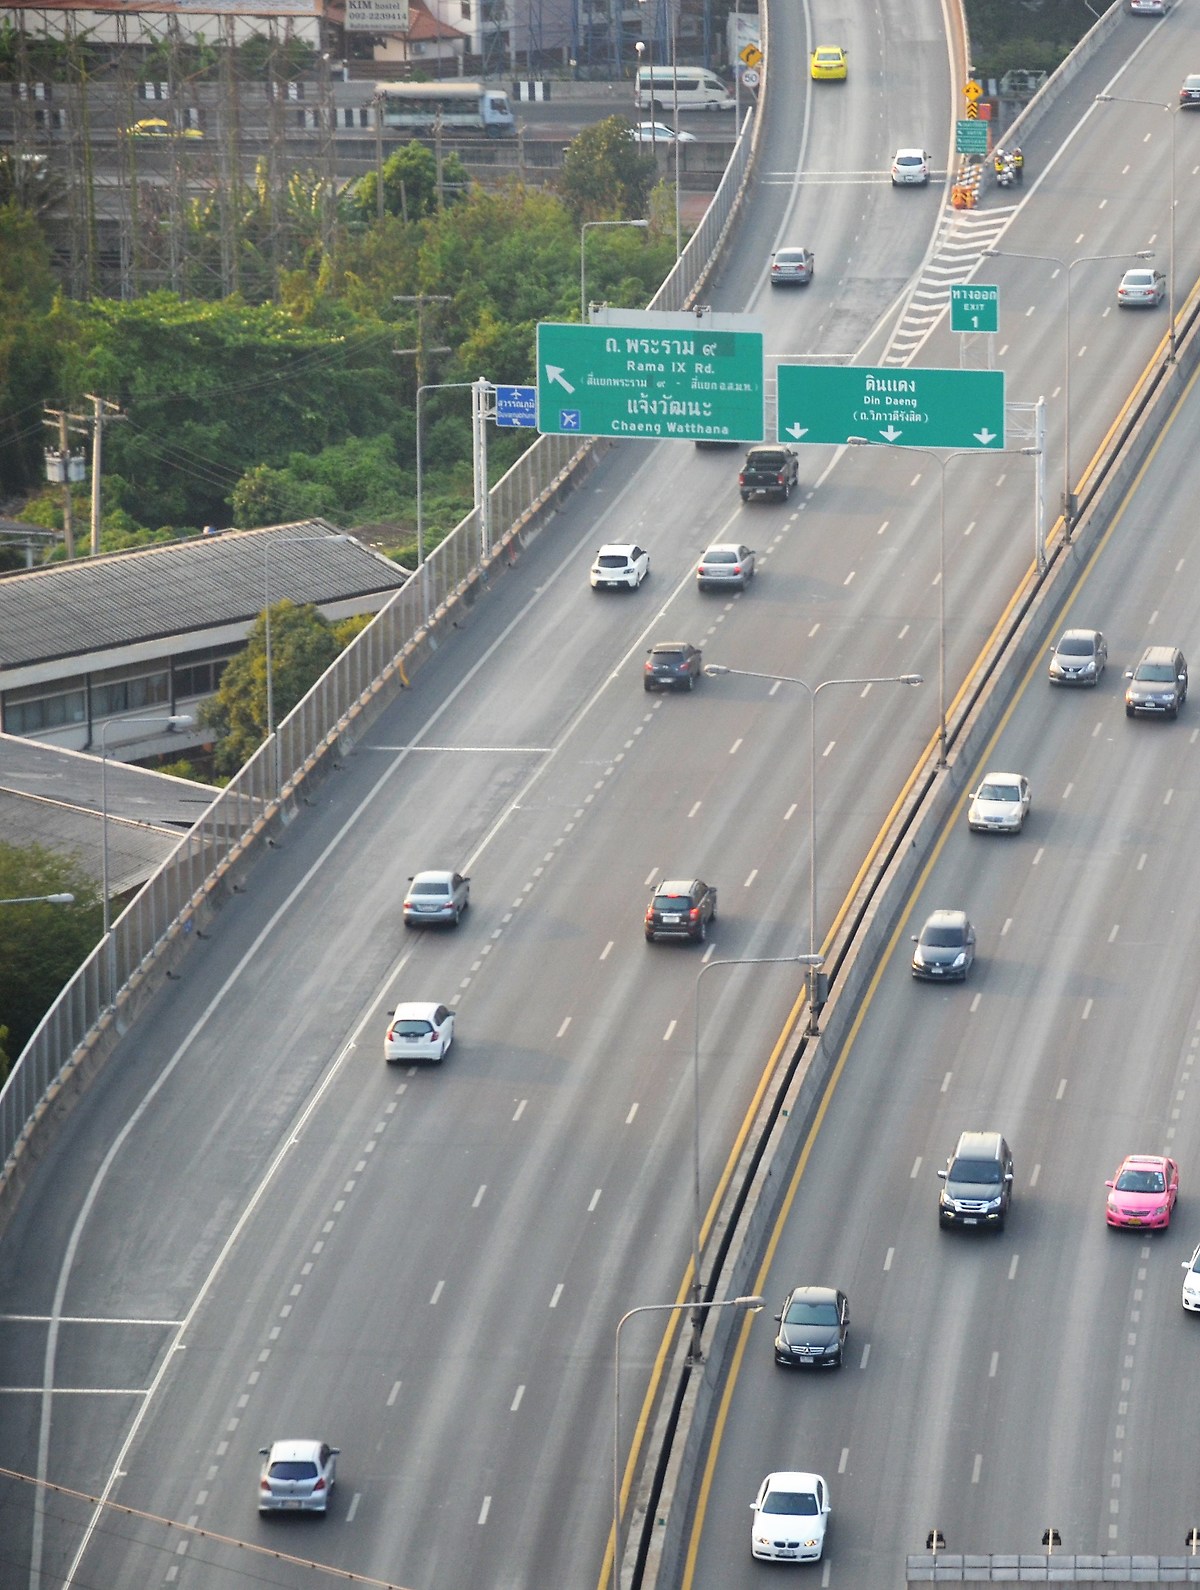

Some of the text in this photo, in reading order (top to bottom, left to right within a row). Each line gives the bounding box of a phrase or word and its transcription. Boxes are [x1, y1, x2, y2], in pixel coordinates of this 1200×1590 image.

[349, 1, 372, 10] KIM
[744, 73, 758, 83] 50
[952, 290, 997, 300] ทางออก
[963, 303, 985, 311] EXIT
[971, 316, 979, 328] 1
[605, 338, 718, 357] ถ. พระราม ๙
[627, 360, 715, 374] Rama IX Rd.
[865, 374, 916, 393] ดินแดง
[627, 392, 713, 418] แจ้งวัฒนะ
[863, 395, 917, 408] Din Daeng
[611, 420, 729, 435] Chaeng Watthana
